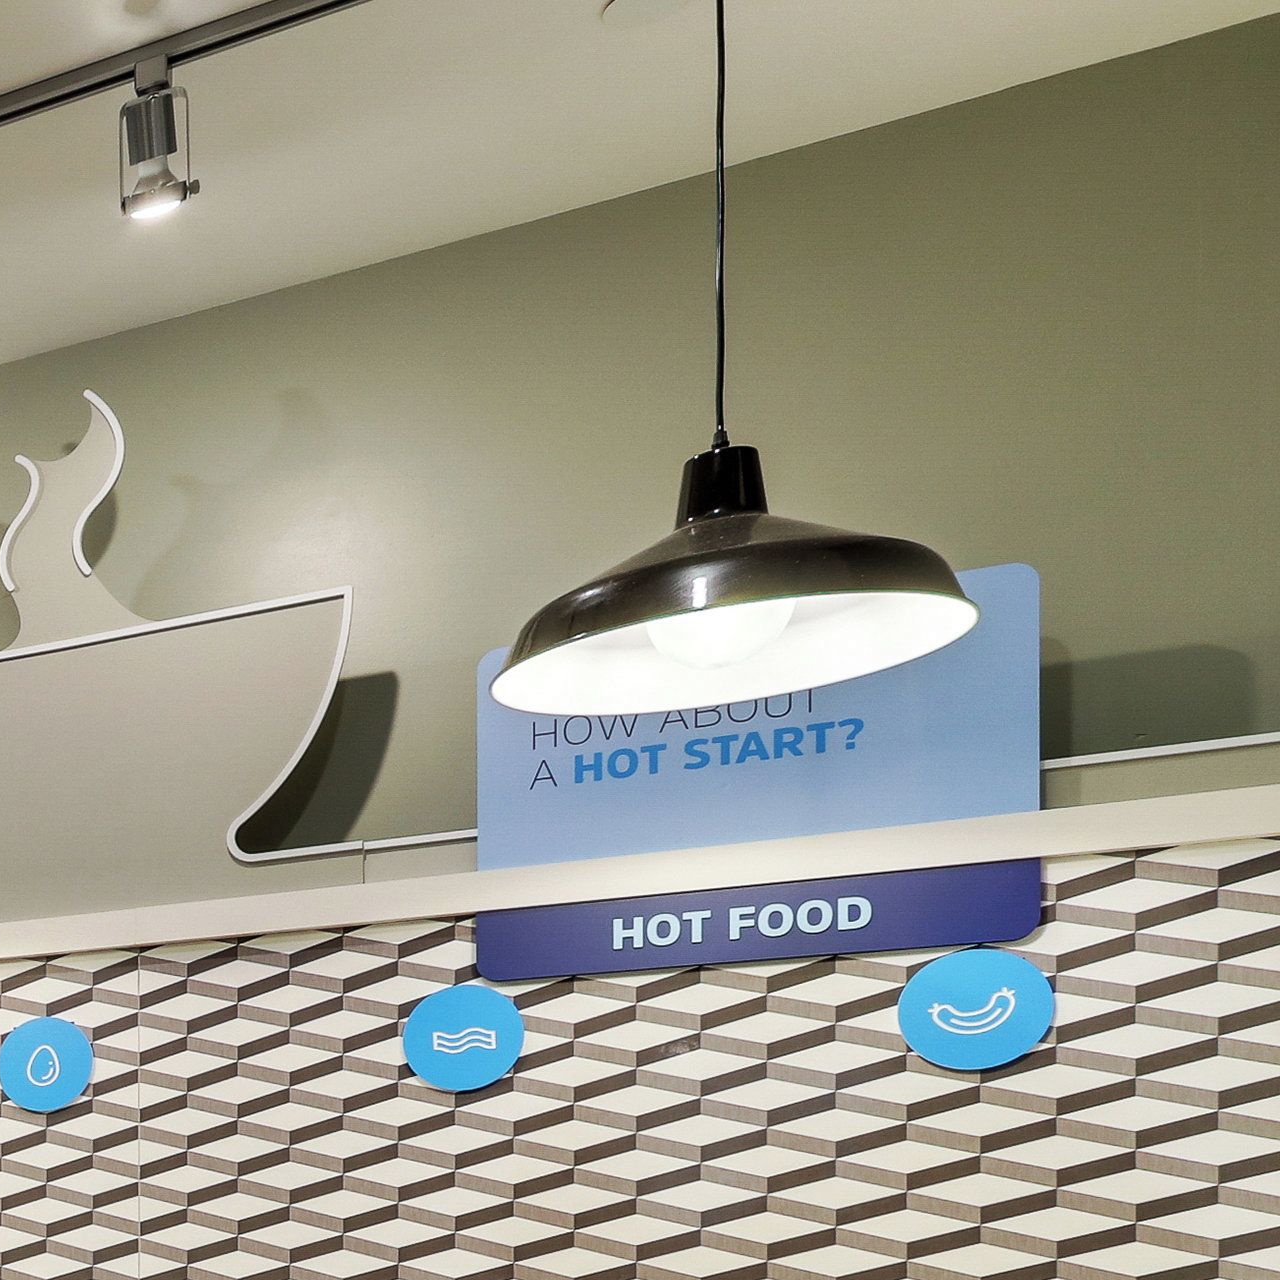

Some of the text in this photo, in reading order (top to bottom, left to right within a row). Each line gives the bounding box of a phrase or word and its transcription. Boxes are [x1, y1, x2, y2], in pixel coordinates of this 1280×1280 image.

[532, 688, 814, 750] HOW ABOUT
[529, 717, 865, 790] A HOT START?
[612, 896, 873, 951] HOT FOOD
